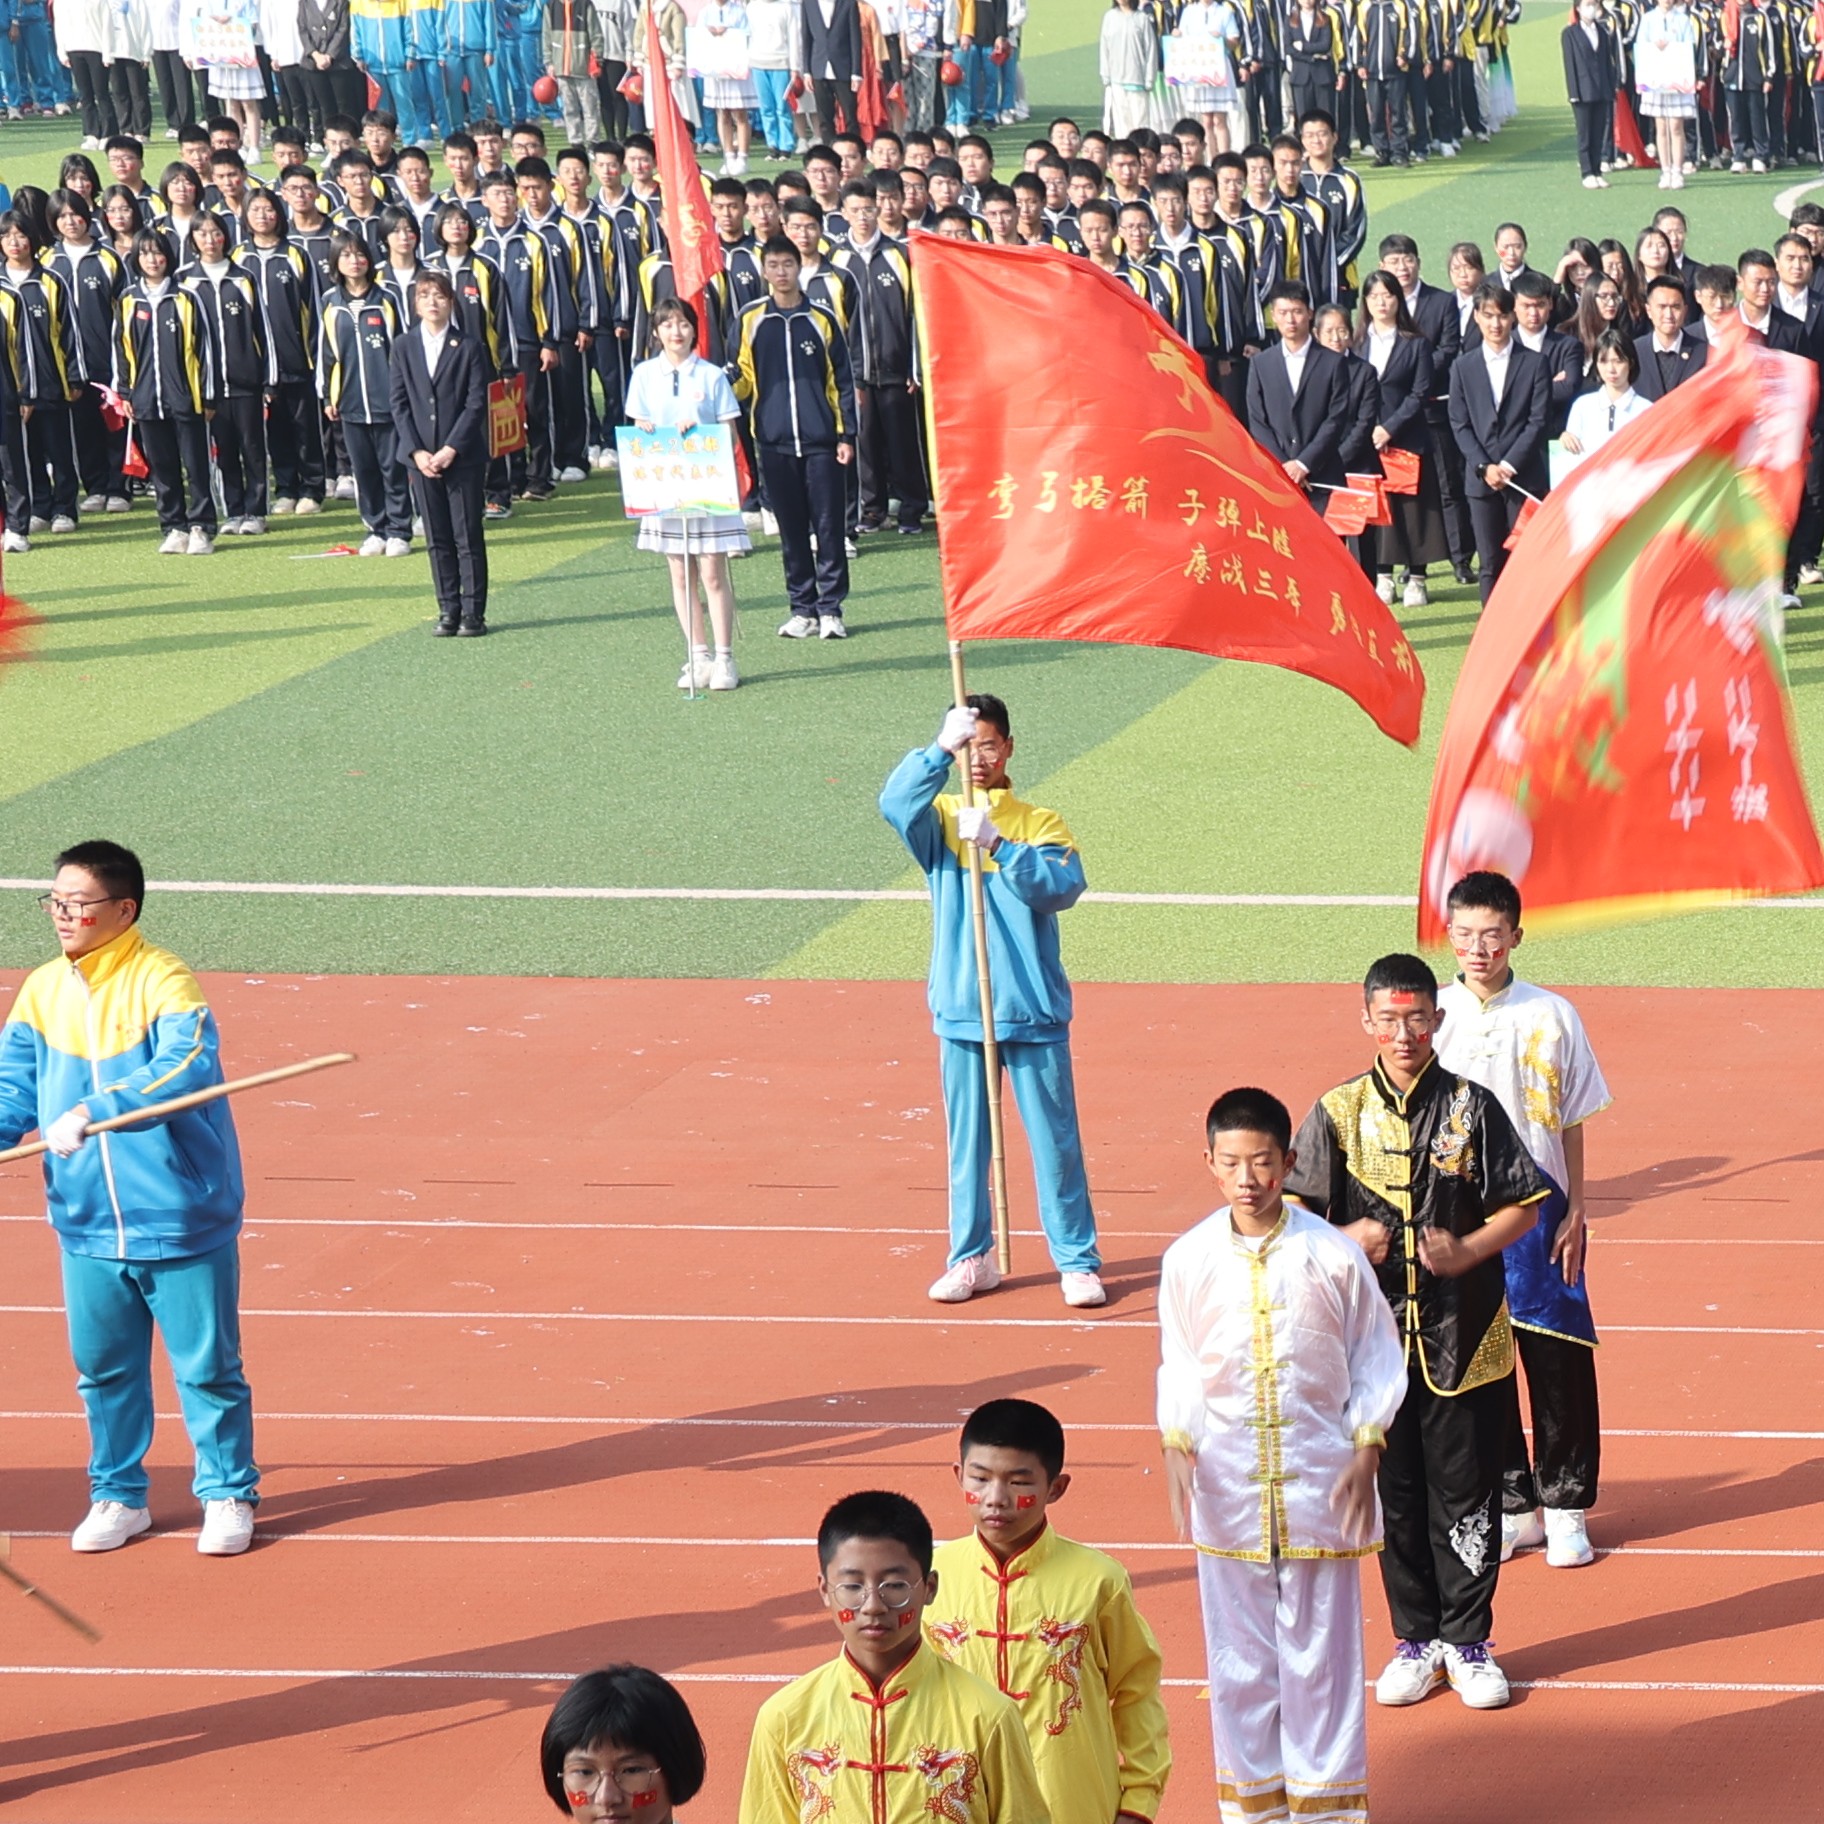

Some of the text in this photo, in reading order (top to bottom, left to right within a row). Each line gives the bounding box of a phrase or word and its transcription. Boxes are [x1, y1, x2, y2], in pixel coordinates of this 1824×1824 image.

[988, 471, 1295, 560] 弯弓搭箭 子弹上膛
